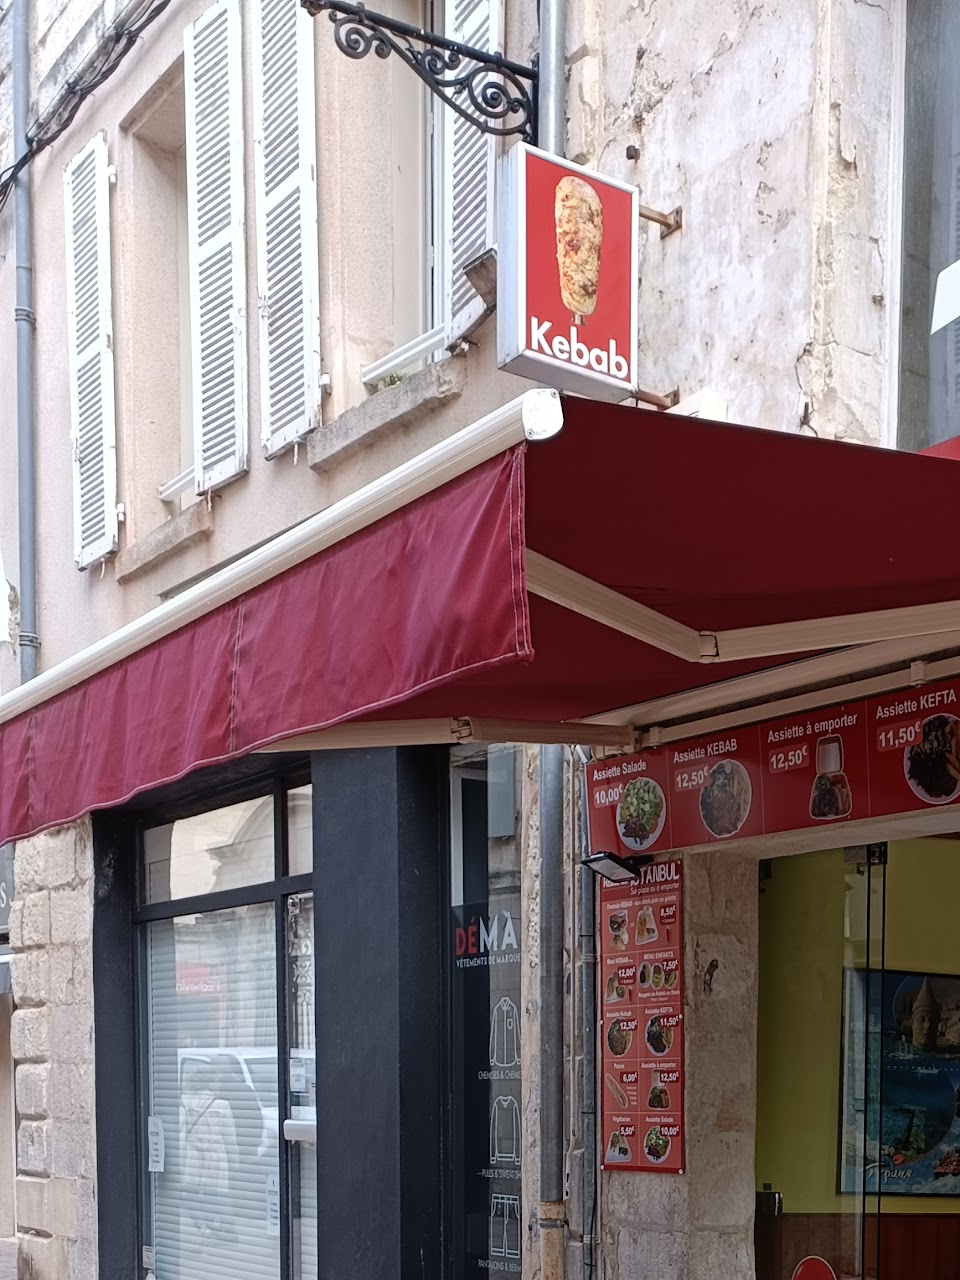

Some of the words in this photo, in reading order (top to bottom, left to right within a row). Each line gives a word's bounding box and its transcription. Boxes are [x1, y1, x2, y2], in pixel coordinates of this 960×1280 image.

[531, 317, 628, 379] Kebab
[876, 695, 918, 720] Assiette
[920, 689, 956, 710] KEFTA
[768, 726, 804, 743] Assiette
[807, 722, 812, 734] à
[814, 713, 857, 735] emporter
[879, 721, 921, 748] 11,50€
[674, 747, 705, 763] Assiette
[707, 739, 737, 756] KEBAB
[771, 745, 808, 770] 12,50€
[593, 764, 621, 781] Assiette
[622, 760, 647, 775] Salade
[676, 767, 710, 789] 12,50€
[595, 784, 623, 804] 10,00€
